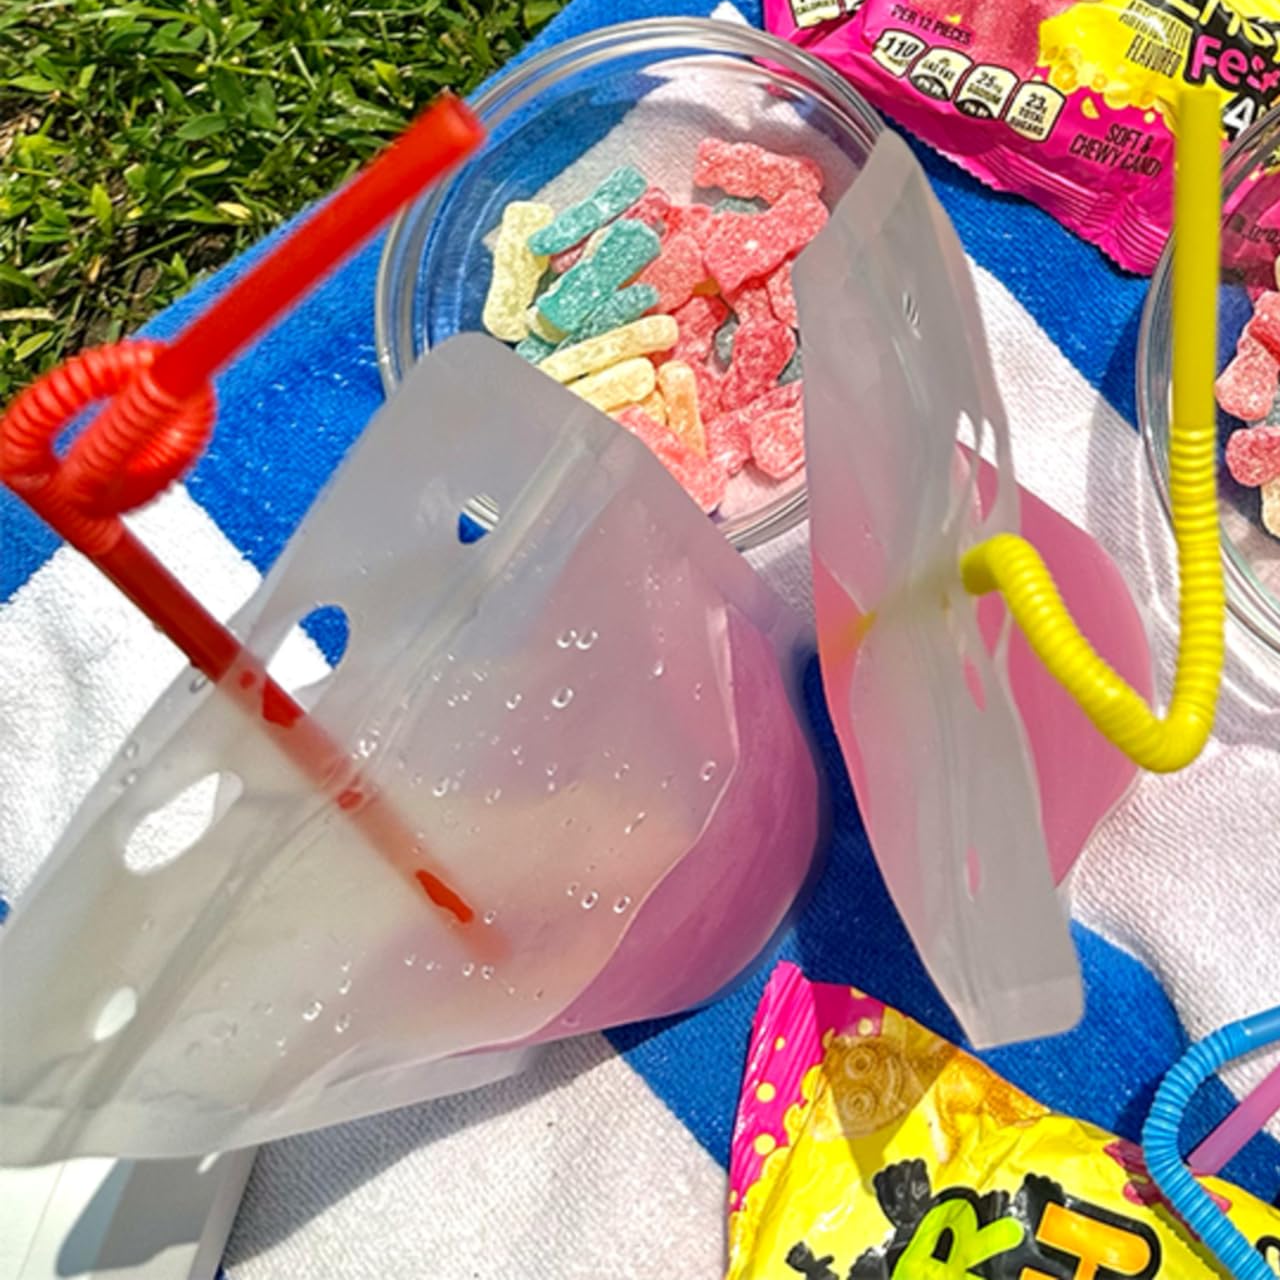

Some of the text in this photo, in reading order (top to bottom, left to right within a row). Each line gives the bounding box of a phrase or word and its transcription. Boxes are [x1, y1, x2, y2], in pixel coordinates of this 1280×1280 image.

[891, 4, 973, 46] PER 12 PIECES
[883, 36, 920, 60] 110
[1069, 132, 1123, 167] CHEWY
[1104, 122, 1143, 151] SOFT
